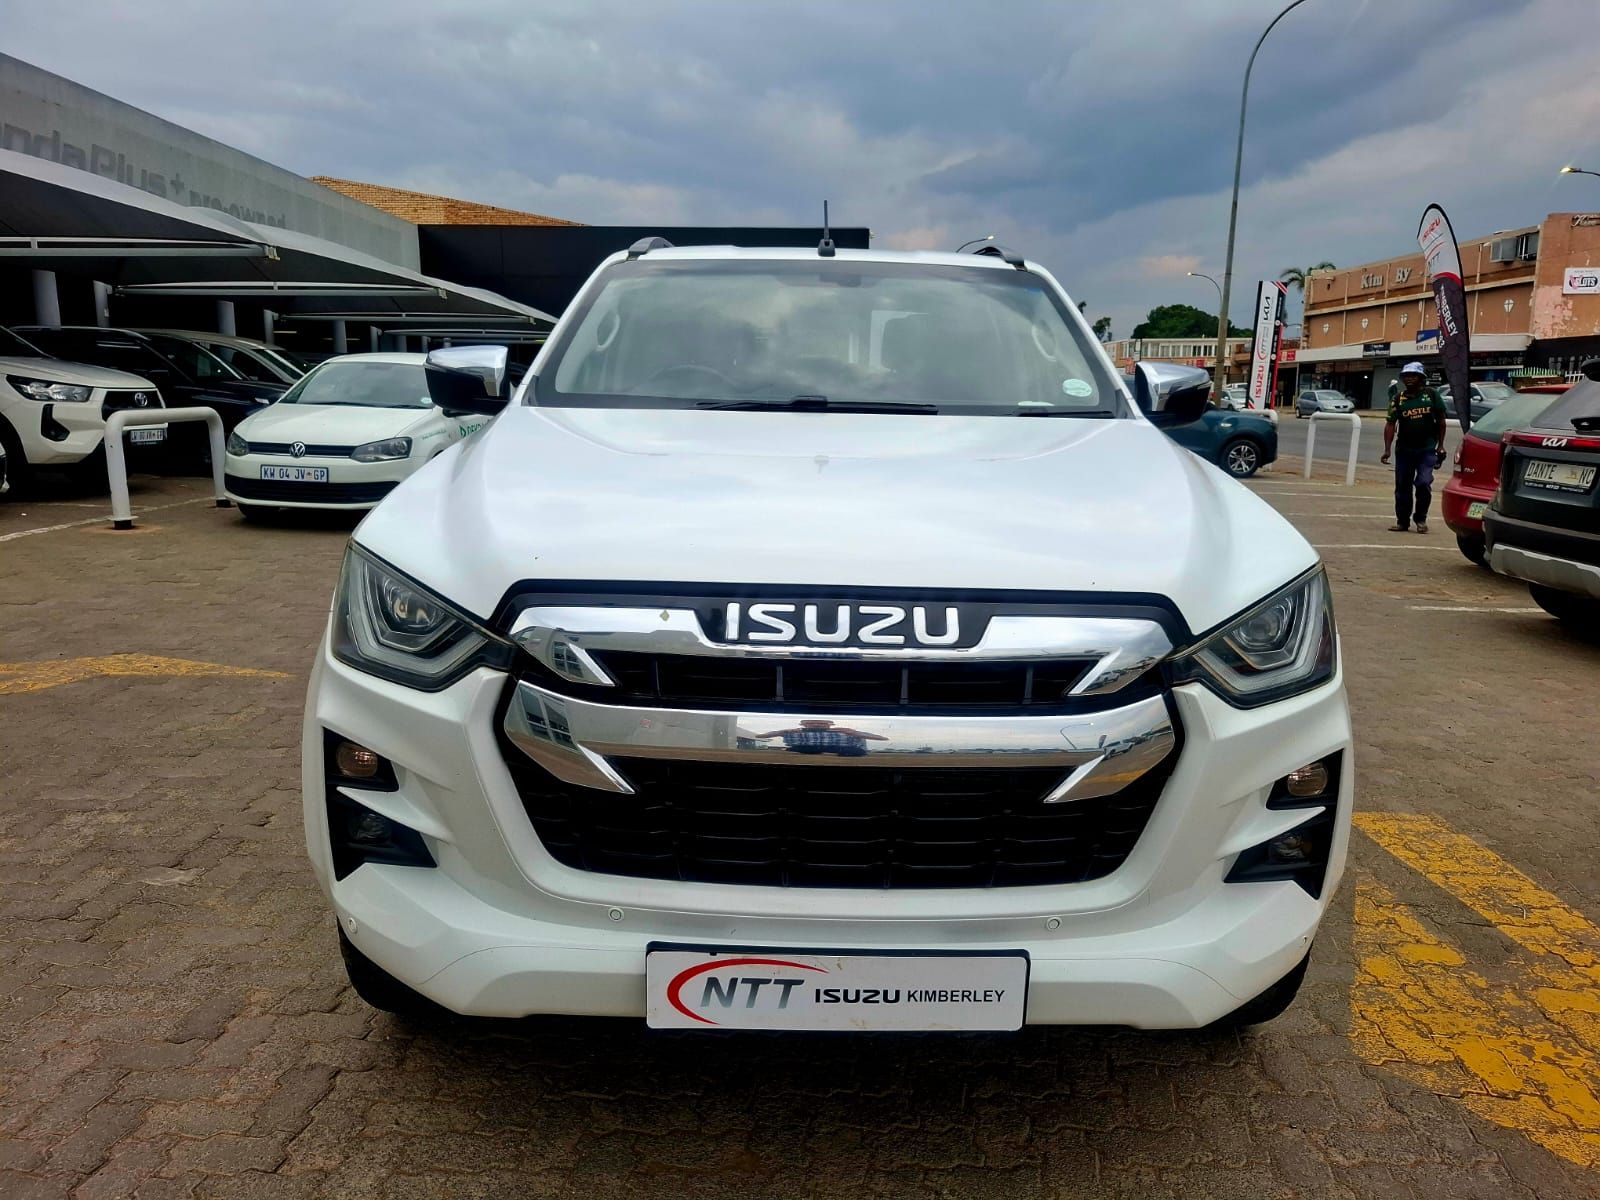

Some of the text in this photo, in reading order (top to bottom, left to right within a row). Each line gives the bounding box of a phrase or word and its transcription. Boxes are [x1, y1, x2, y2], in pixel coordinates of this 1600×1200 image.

[1361, 273, 1383, 289] Kim
[1255, 365, 1264, 398] ISUZU
[1402, 406, 1431, 417] CASTLE
[1542, 438, 1567, 447] KIA
[263, 467, 326, 481] KW 04 JV GP
[1527, 462, 1595, 485] DANTE NC
[725, 602, 961, 645] ISUZU
[700, 976, 1006, 1010] NTT ISUZU KIMBERLEY
